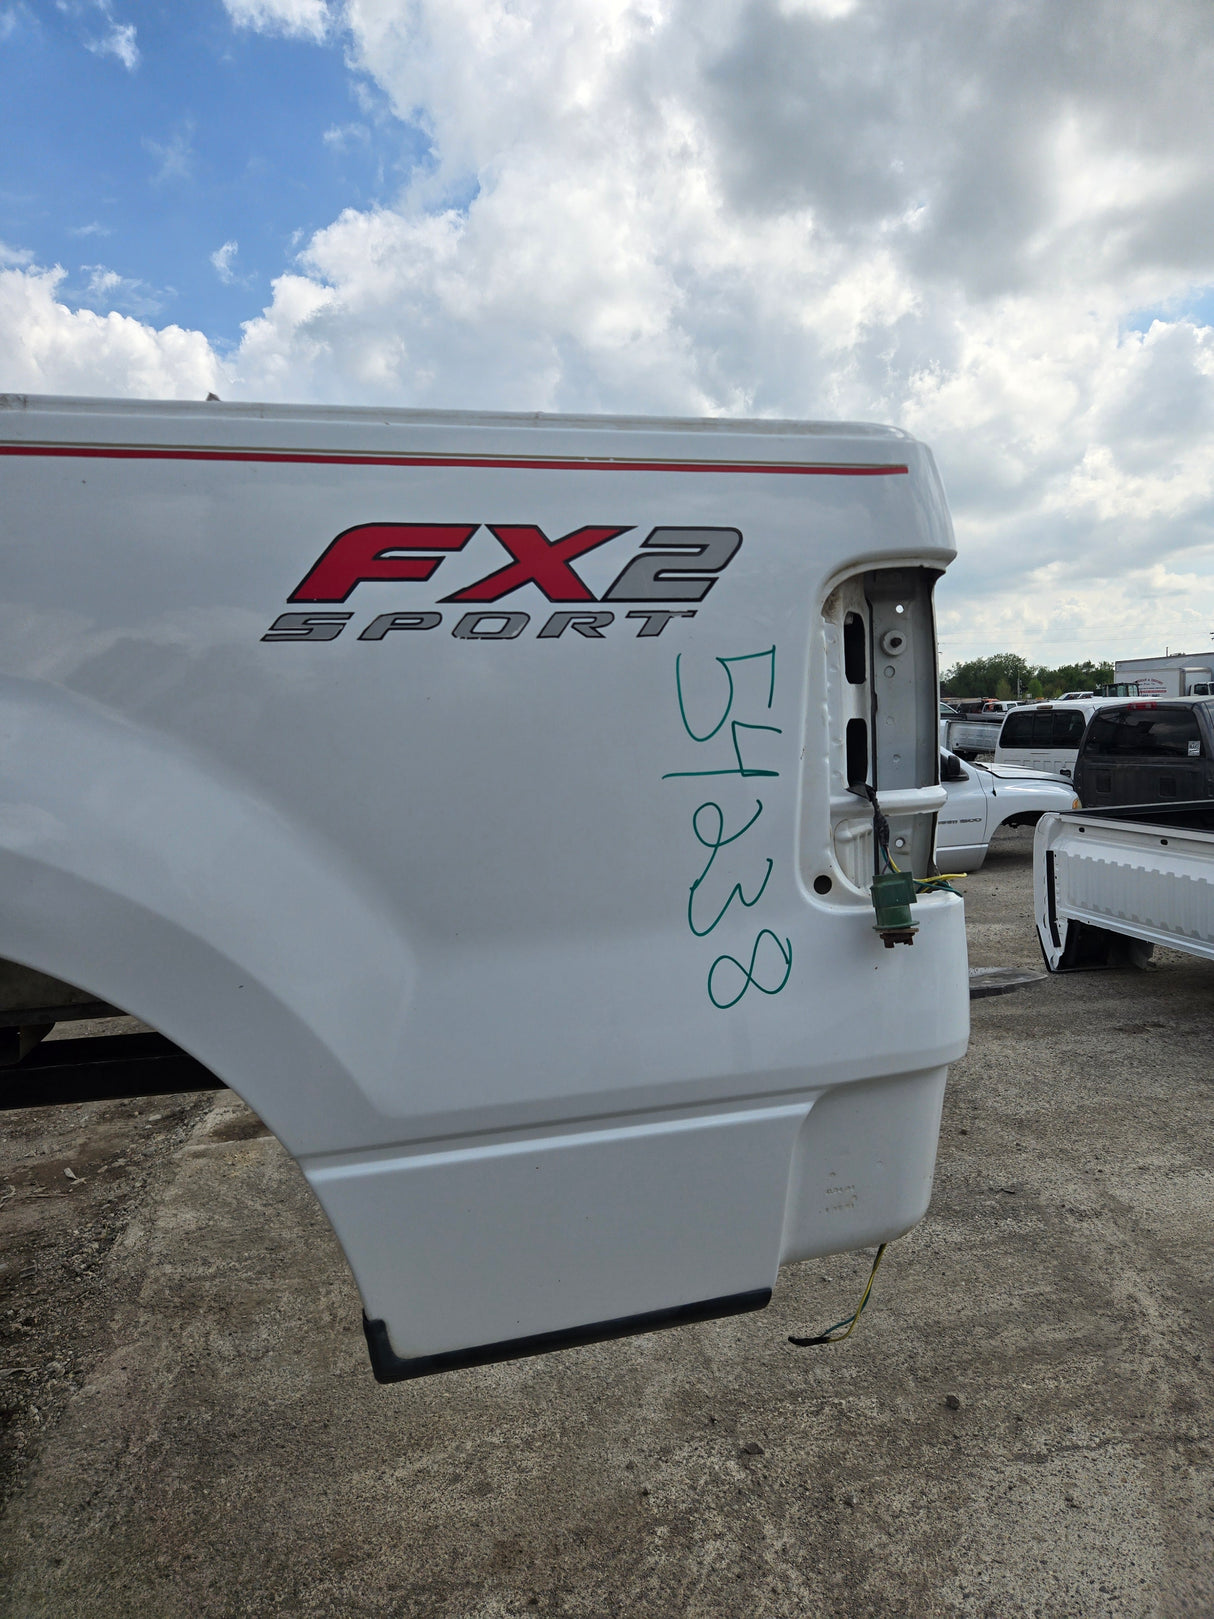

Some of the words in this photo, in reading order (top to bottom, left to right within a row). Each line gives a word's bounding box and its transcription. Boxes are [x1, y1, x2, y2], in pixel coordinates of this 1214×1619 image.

[286, 522, 744, 603] FX2
[260, 609, 698, 641] SPORT
[662, 644, 792, 1009] 54238
